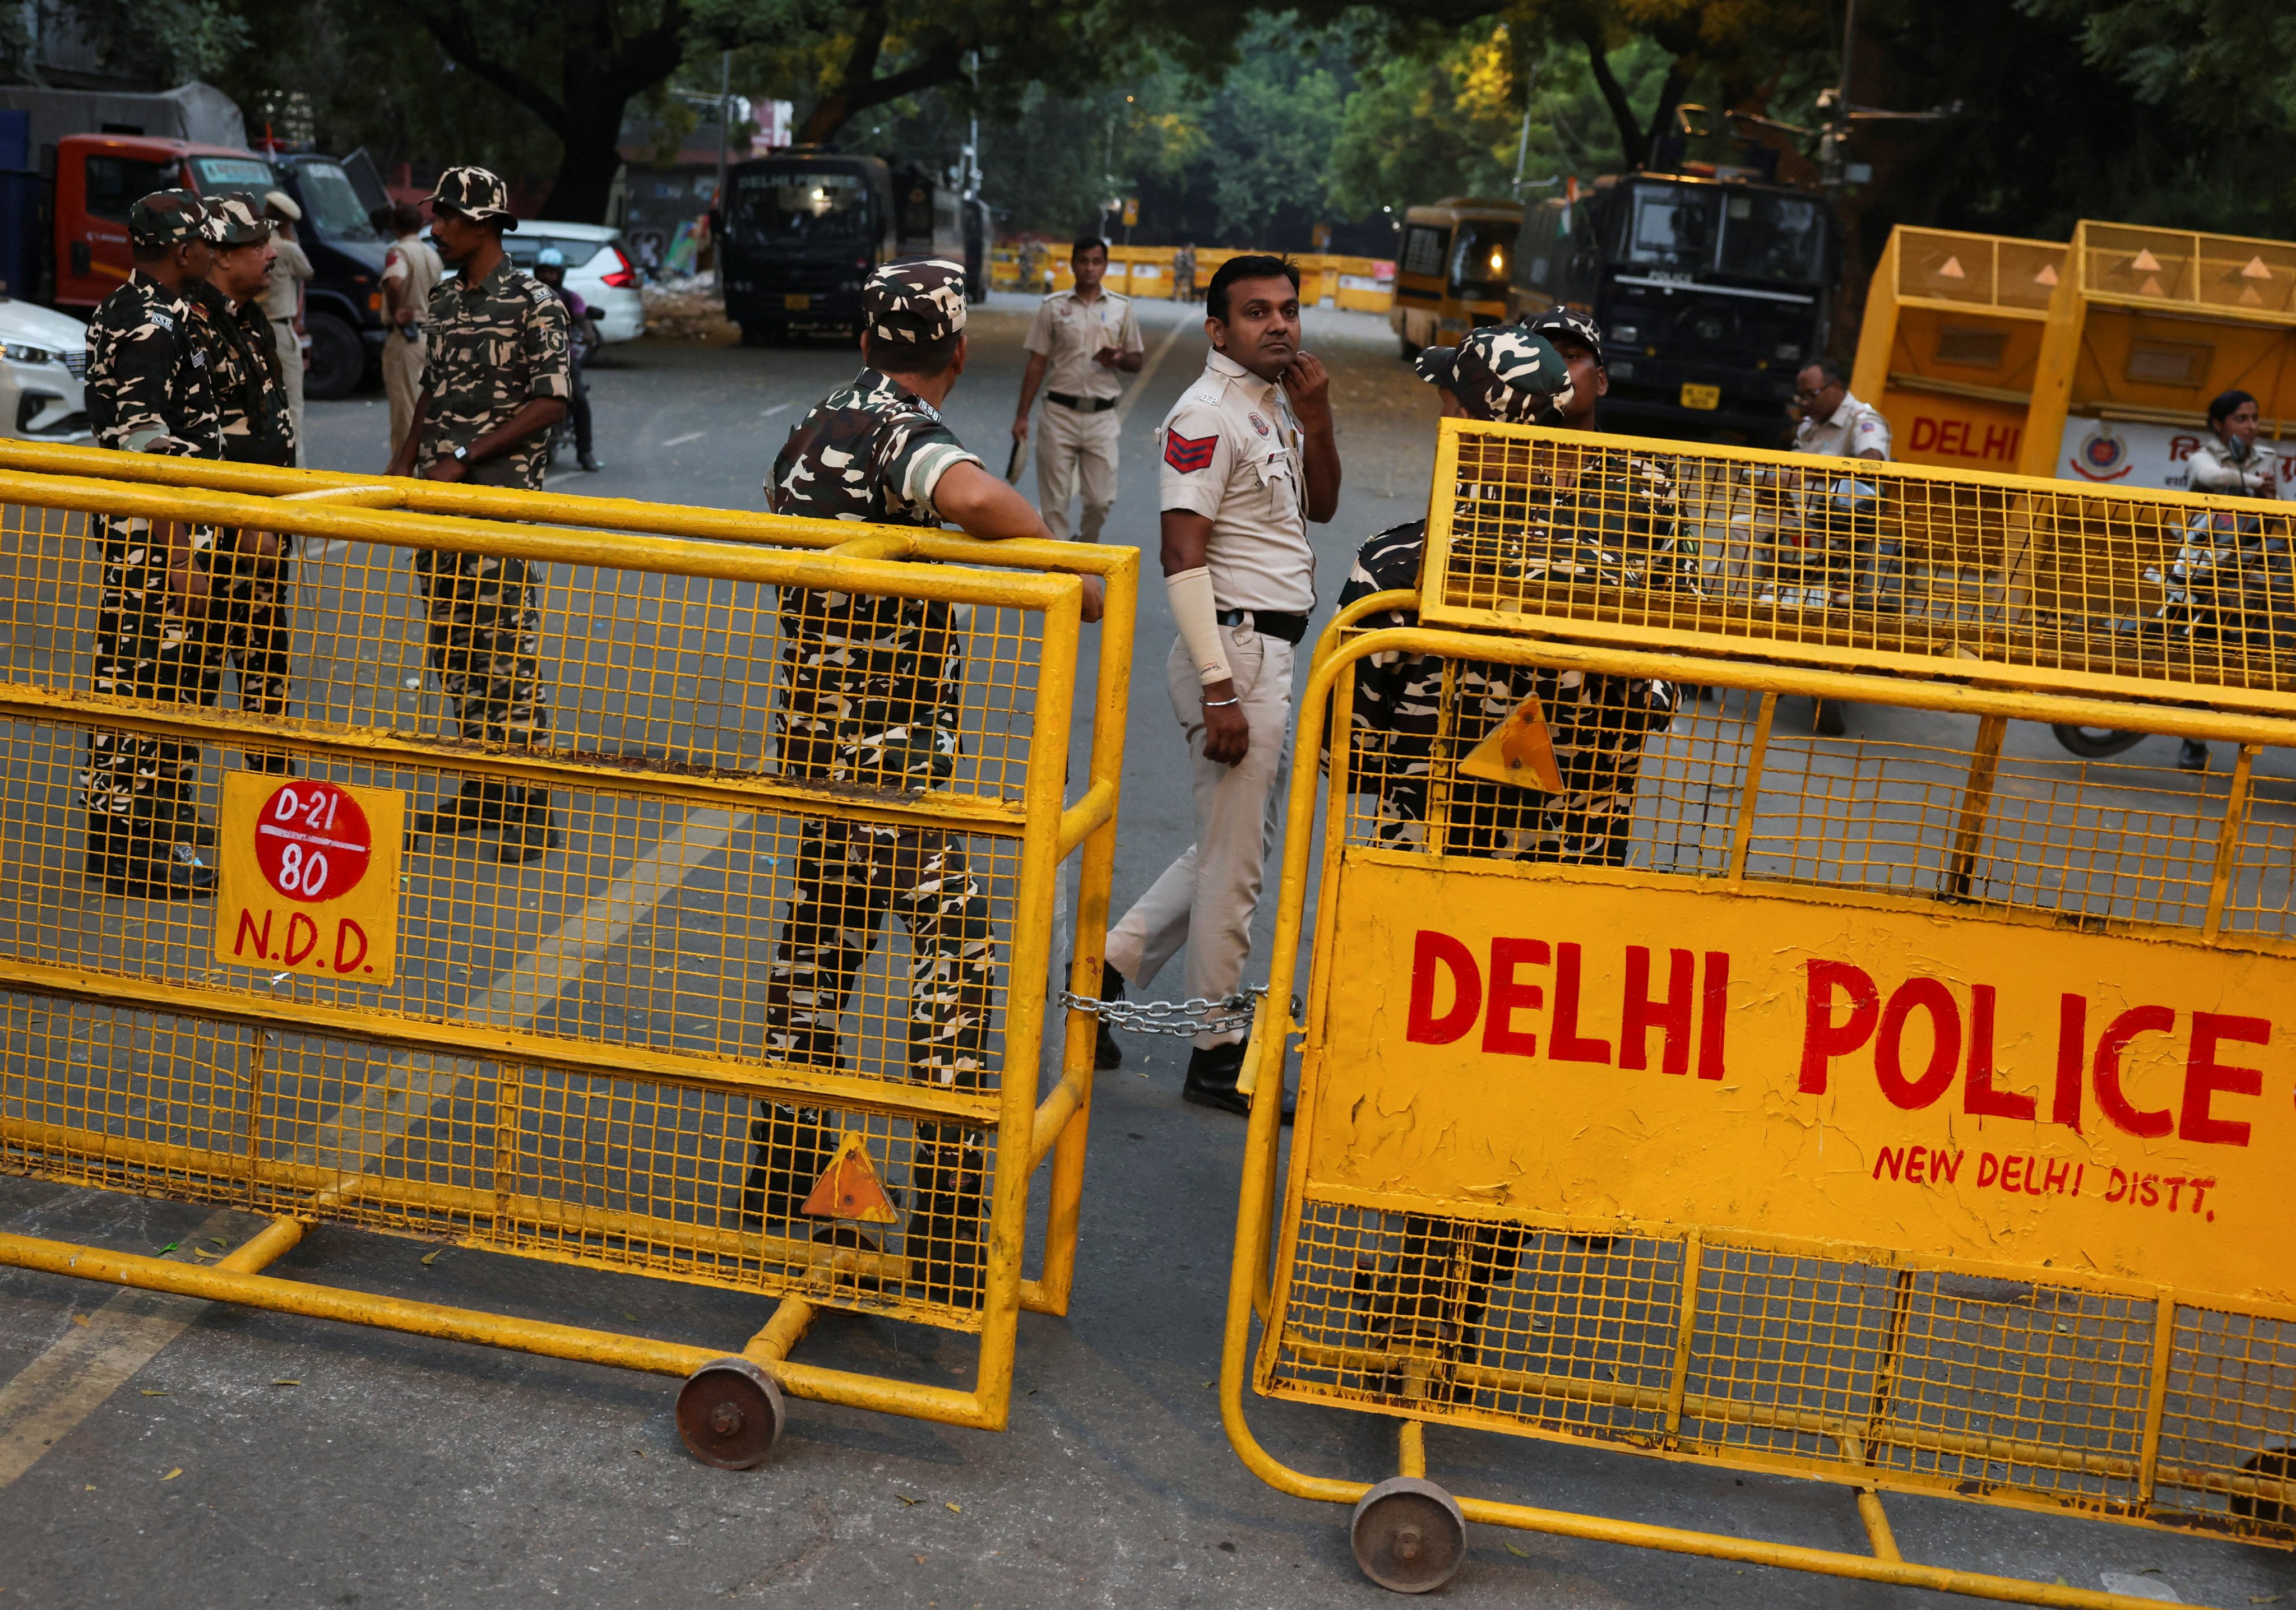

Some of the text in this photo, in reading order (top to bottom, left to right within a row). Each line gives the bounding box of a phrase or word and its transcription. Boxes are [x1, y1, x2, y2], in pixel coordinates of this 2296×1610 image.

[1909, 416, 2020, 462] DELHI
[275, 788, 337, 830] D-21
[279, 843, 328, 896] 80
[234, 908, 373, 973] N.D.D.
[1406, 930, 2272, 1147] DELHI POLICE
[1872, 1145, 2218, 1222] NEW DELHI DISTT.
